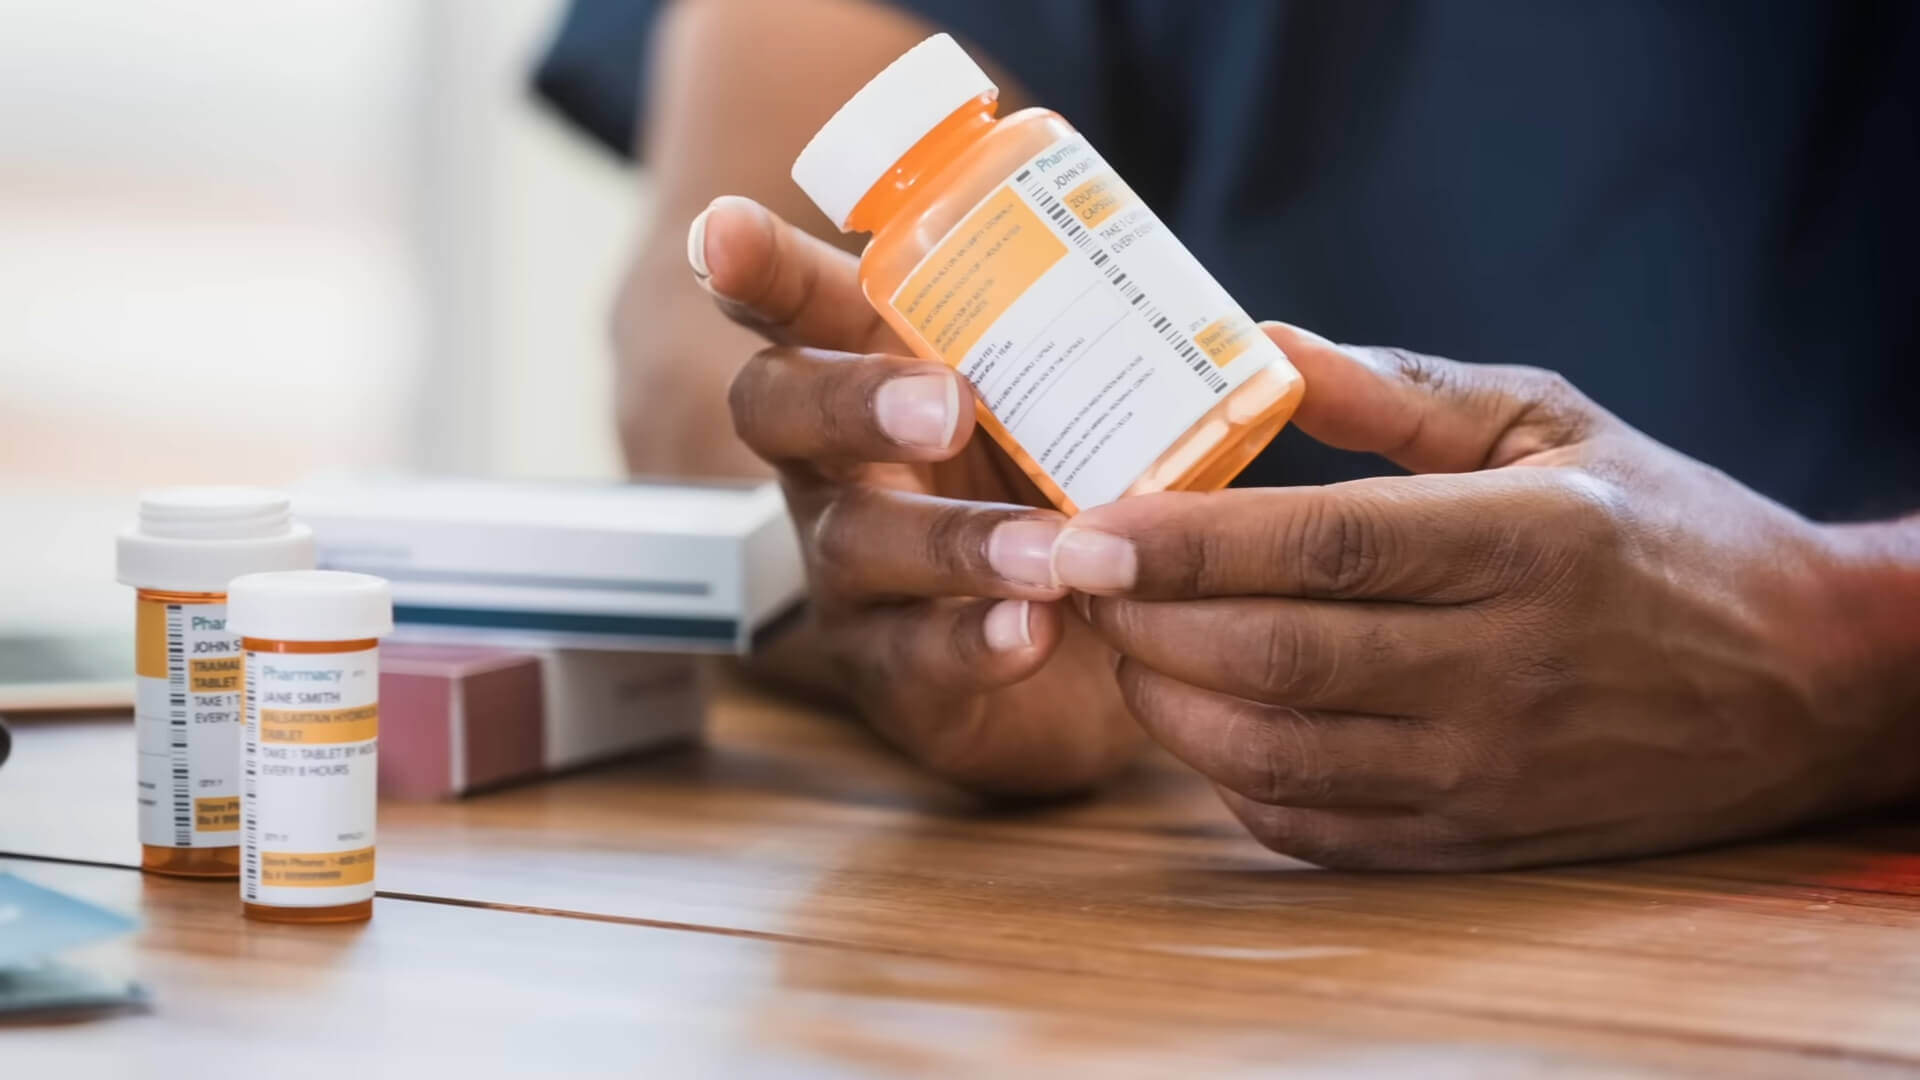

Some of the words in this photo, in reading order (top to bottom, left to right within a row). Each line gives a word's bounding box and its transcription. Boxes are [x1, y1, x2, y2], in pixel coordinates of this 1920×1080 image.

[1053, 165, 1079, 190] JOHN
[192, 641, 230, 653] JOHN
[262, 665, 344, 683] Pharmacy
[193, 676, 239, 689] TABLET
[194, 695, 222, 706] TAKE
[262, 691, 293, 703] JANE
[297, 691, 341, 704] SMITH
[195, 711, 230, 724] EVERY
[300, 747, 343, 760] TABLET
[262, 764, 295, 776] EVERY
[308, 764, 350, 776] HOURS
